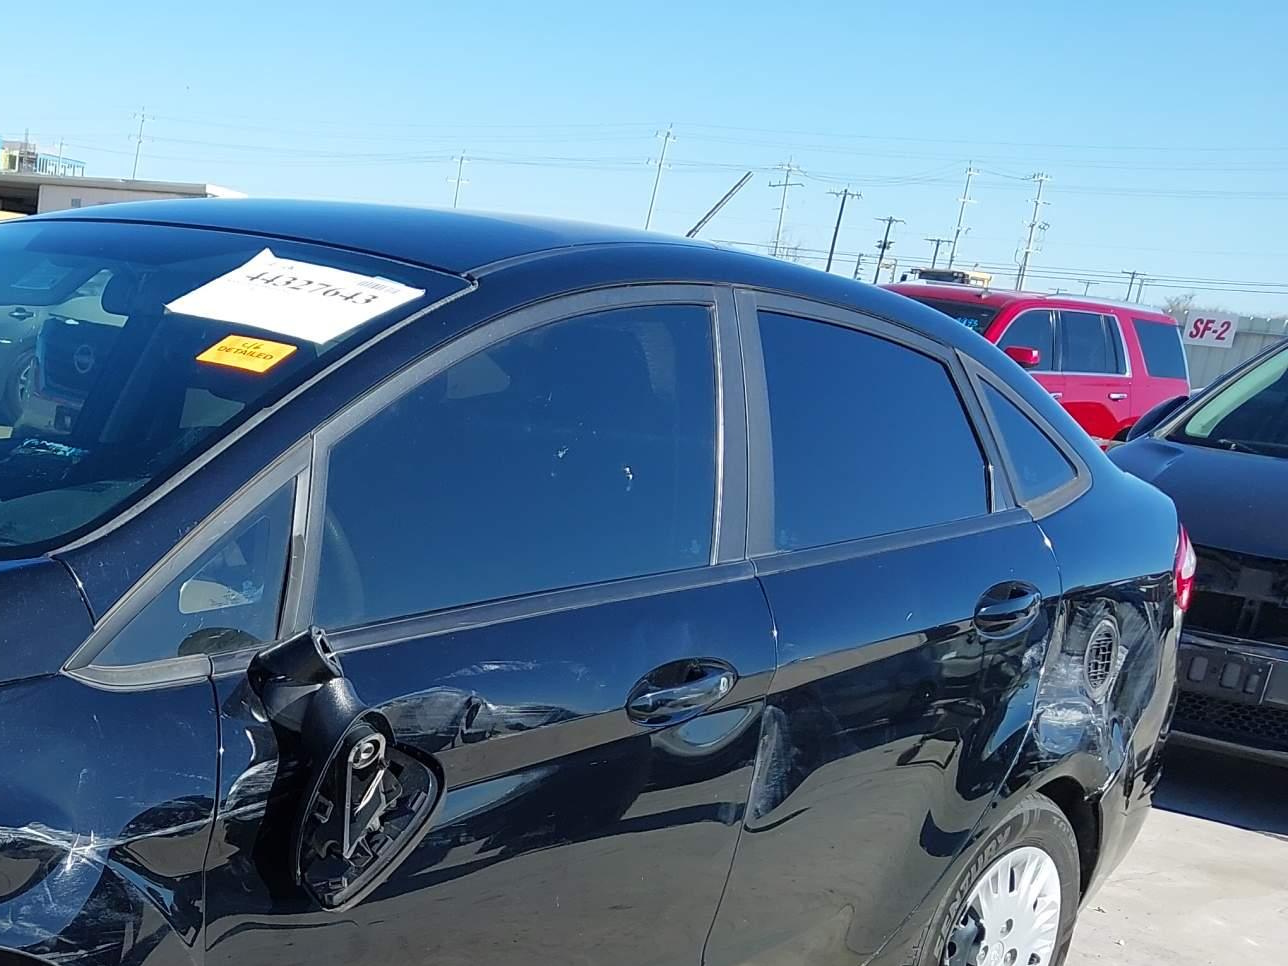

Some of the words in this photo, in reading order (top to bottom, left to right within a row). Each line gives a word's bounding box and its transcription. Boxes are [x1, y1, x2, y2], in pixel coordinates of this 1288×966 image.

[246, 271, 377, 304] 44327643
[1189, 318, 1231, 340] SF-2
[217, 345, 274, 360] DETAILED
